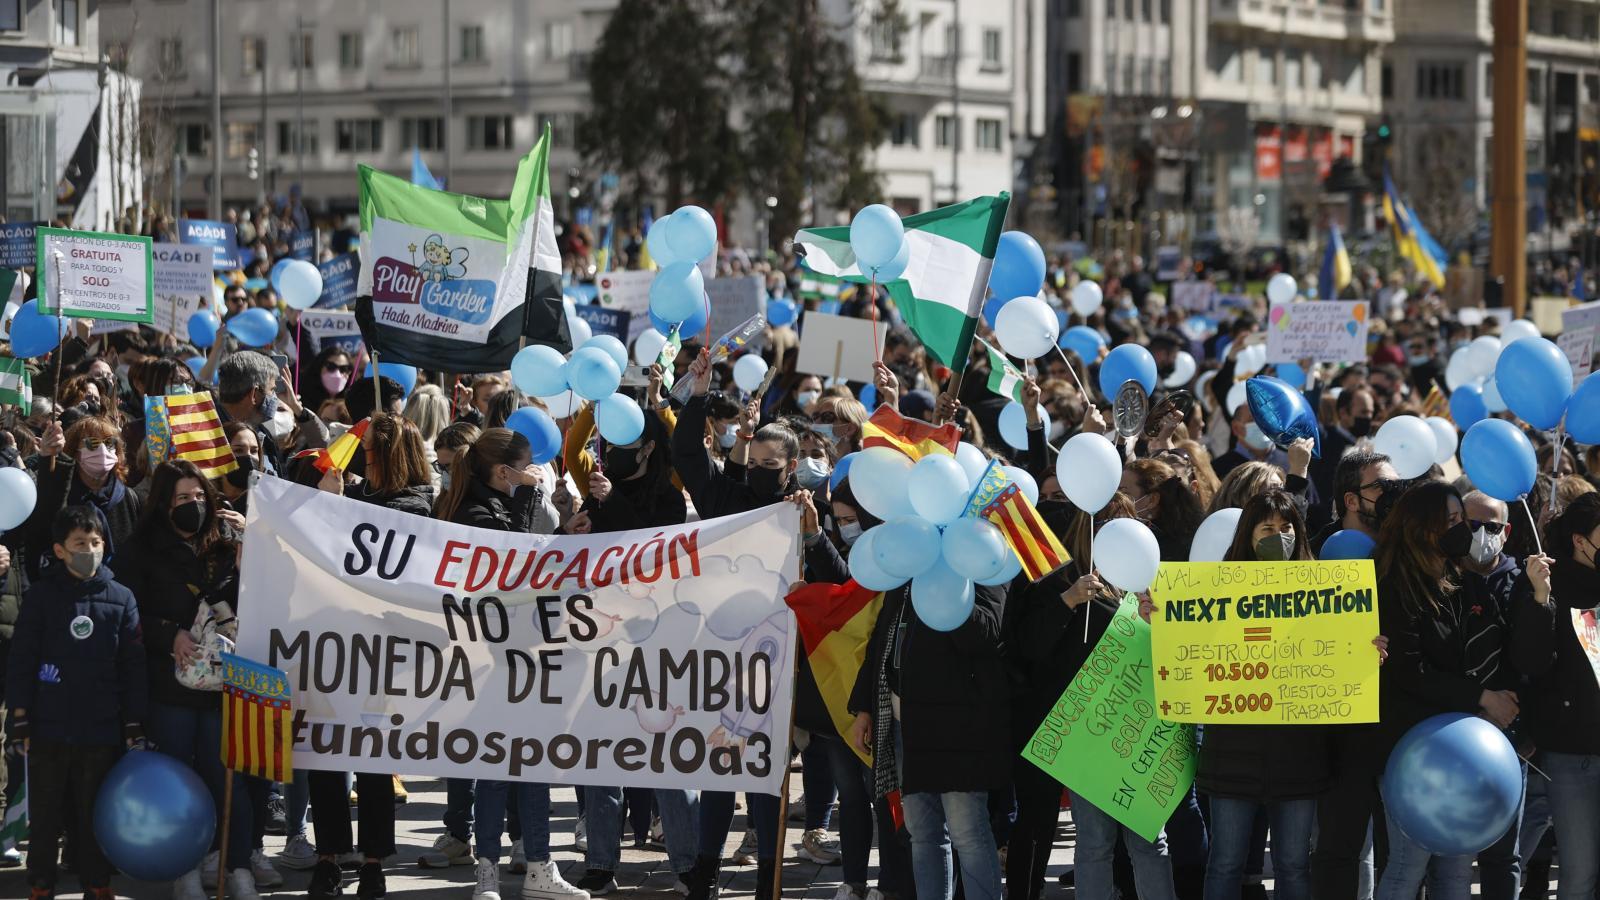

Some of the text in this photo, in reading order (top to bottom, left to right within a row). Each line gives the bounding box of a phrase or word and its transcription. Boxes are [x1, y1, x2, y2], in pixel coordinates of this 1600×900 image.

[188, 225, 226, 240] ACADE
[71, 248, 122, 262] GRATUITA
[71, 263, 124, 274] PARA TODOS Y
[321, 258, 352, 280] CADE
[82, 276, 110, 287] SOLO
[377, 264, 420, 303] Play
[427, 282, 487, 313] Garden
[72, 300, 120, 311] AUTORIZADOS
[74, 289, 107, 299] CENTROS
[108, 292, 118, 300] DE
[119, 293, 130, 301] 0-3
[304, 318, 353, 330] ACADE
[381, 306, 460, 335] Hada Madrina
[579, 311, 618, 327] CADE
[343, 522, 701, 593] SU EDUCACIÓN
[1153, 567, 1201, 592] MAL
[1251, 566, 1280, 586] DE
[1284, 561, 1360, 586] FONDOS
[442, 594, 599, 644] NO ES
[1165, 597, 1232, 623] NEXT
[1312, 639, 1336, 657] DE
[268, 628, 772, 717] MONEDA DE CAMBIO
[1173, 667, 1193, 681] DE
[1203, 661, 1269, 682] 10.500
[1271, 664, 1335, 680] CENTROS
[1172, 701, 1192, 715] DE
[1204, 692, 1273, 715] 75.000
[1278, 684, 1337, 699] PUESTOS
[1342, 683, 1362, 697] DE
[1275, 700, 1352, 722] TRABAJO
[1111, 700, 1154, 759] SOLO
[1112, 777, 1137, 810] EN
